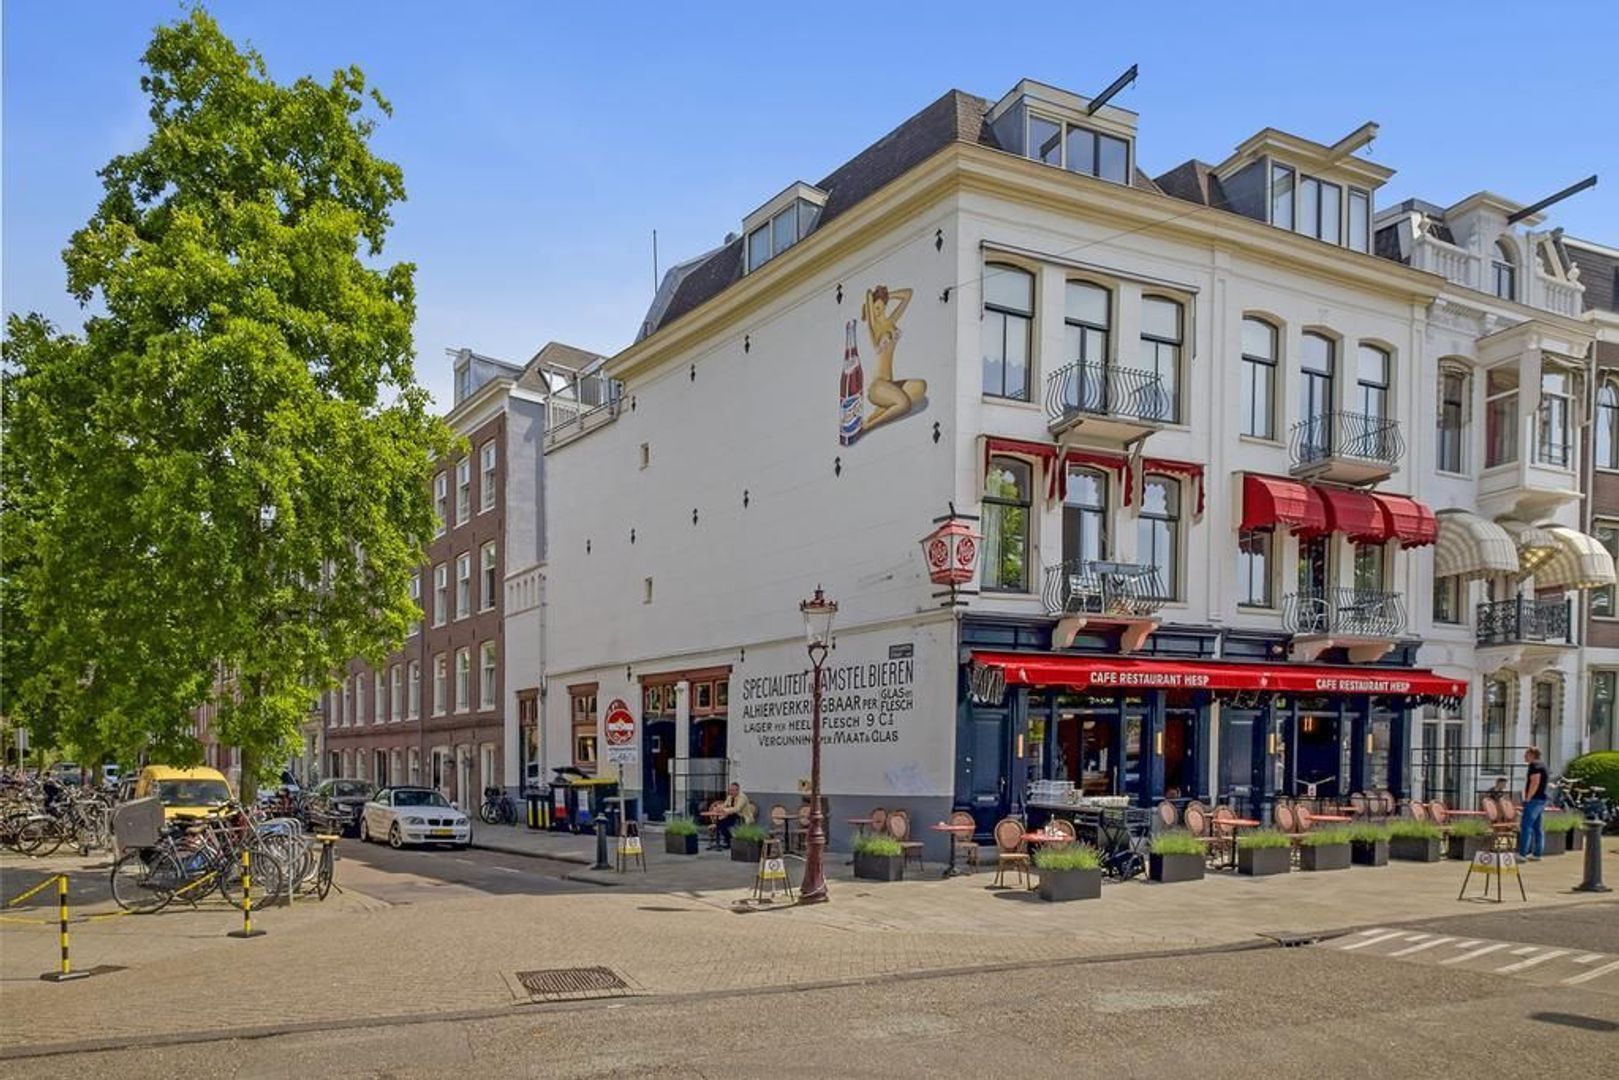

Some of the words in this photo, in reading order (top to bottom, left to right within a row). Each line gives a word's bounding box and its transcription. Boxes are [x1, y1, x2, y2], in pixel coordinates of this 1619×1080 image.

[1090, 671, 1117, 684] CAFE
[1119, 672, 1182, 686] RESTAURANT
[1184, 674, 1210, 686] HESP
[1315, 678, 1337, 690] CAFE
[1339, 679, 1389, 692] RESTAURANT
[1390, 681, 1410, 693] HESP
[743, 673, 808, 700] SPECIALITEIT
[881, 687, 905, 700] GLAS
[863, 698, 878, 710] PER
[880, 699, 913, 712] FLESCH
[744, 722, 773, 734] LAGER
[822, 716, 860, 729] FLESCH
[866, 713, 875, 727] 9
[758, 735, 814, 747] VERGUNNIN
[833, 731, 865, 745] MAAT
[871, 729, 899, 743] GLAS
